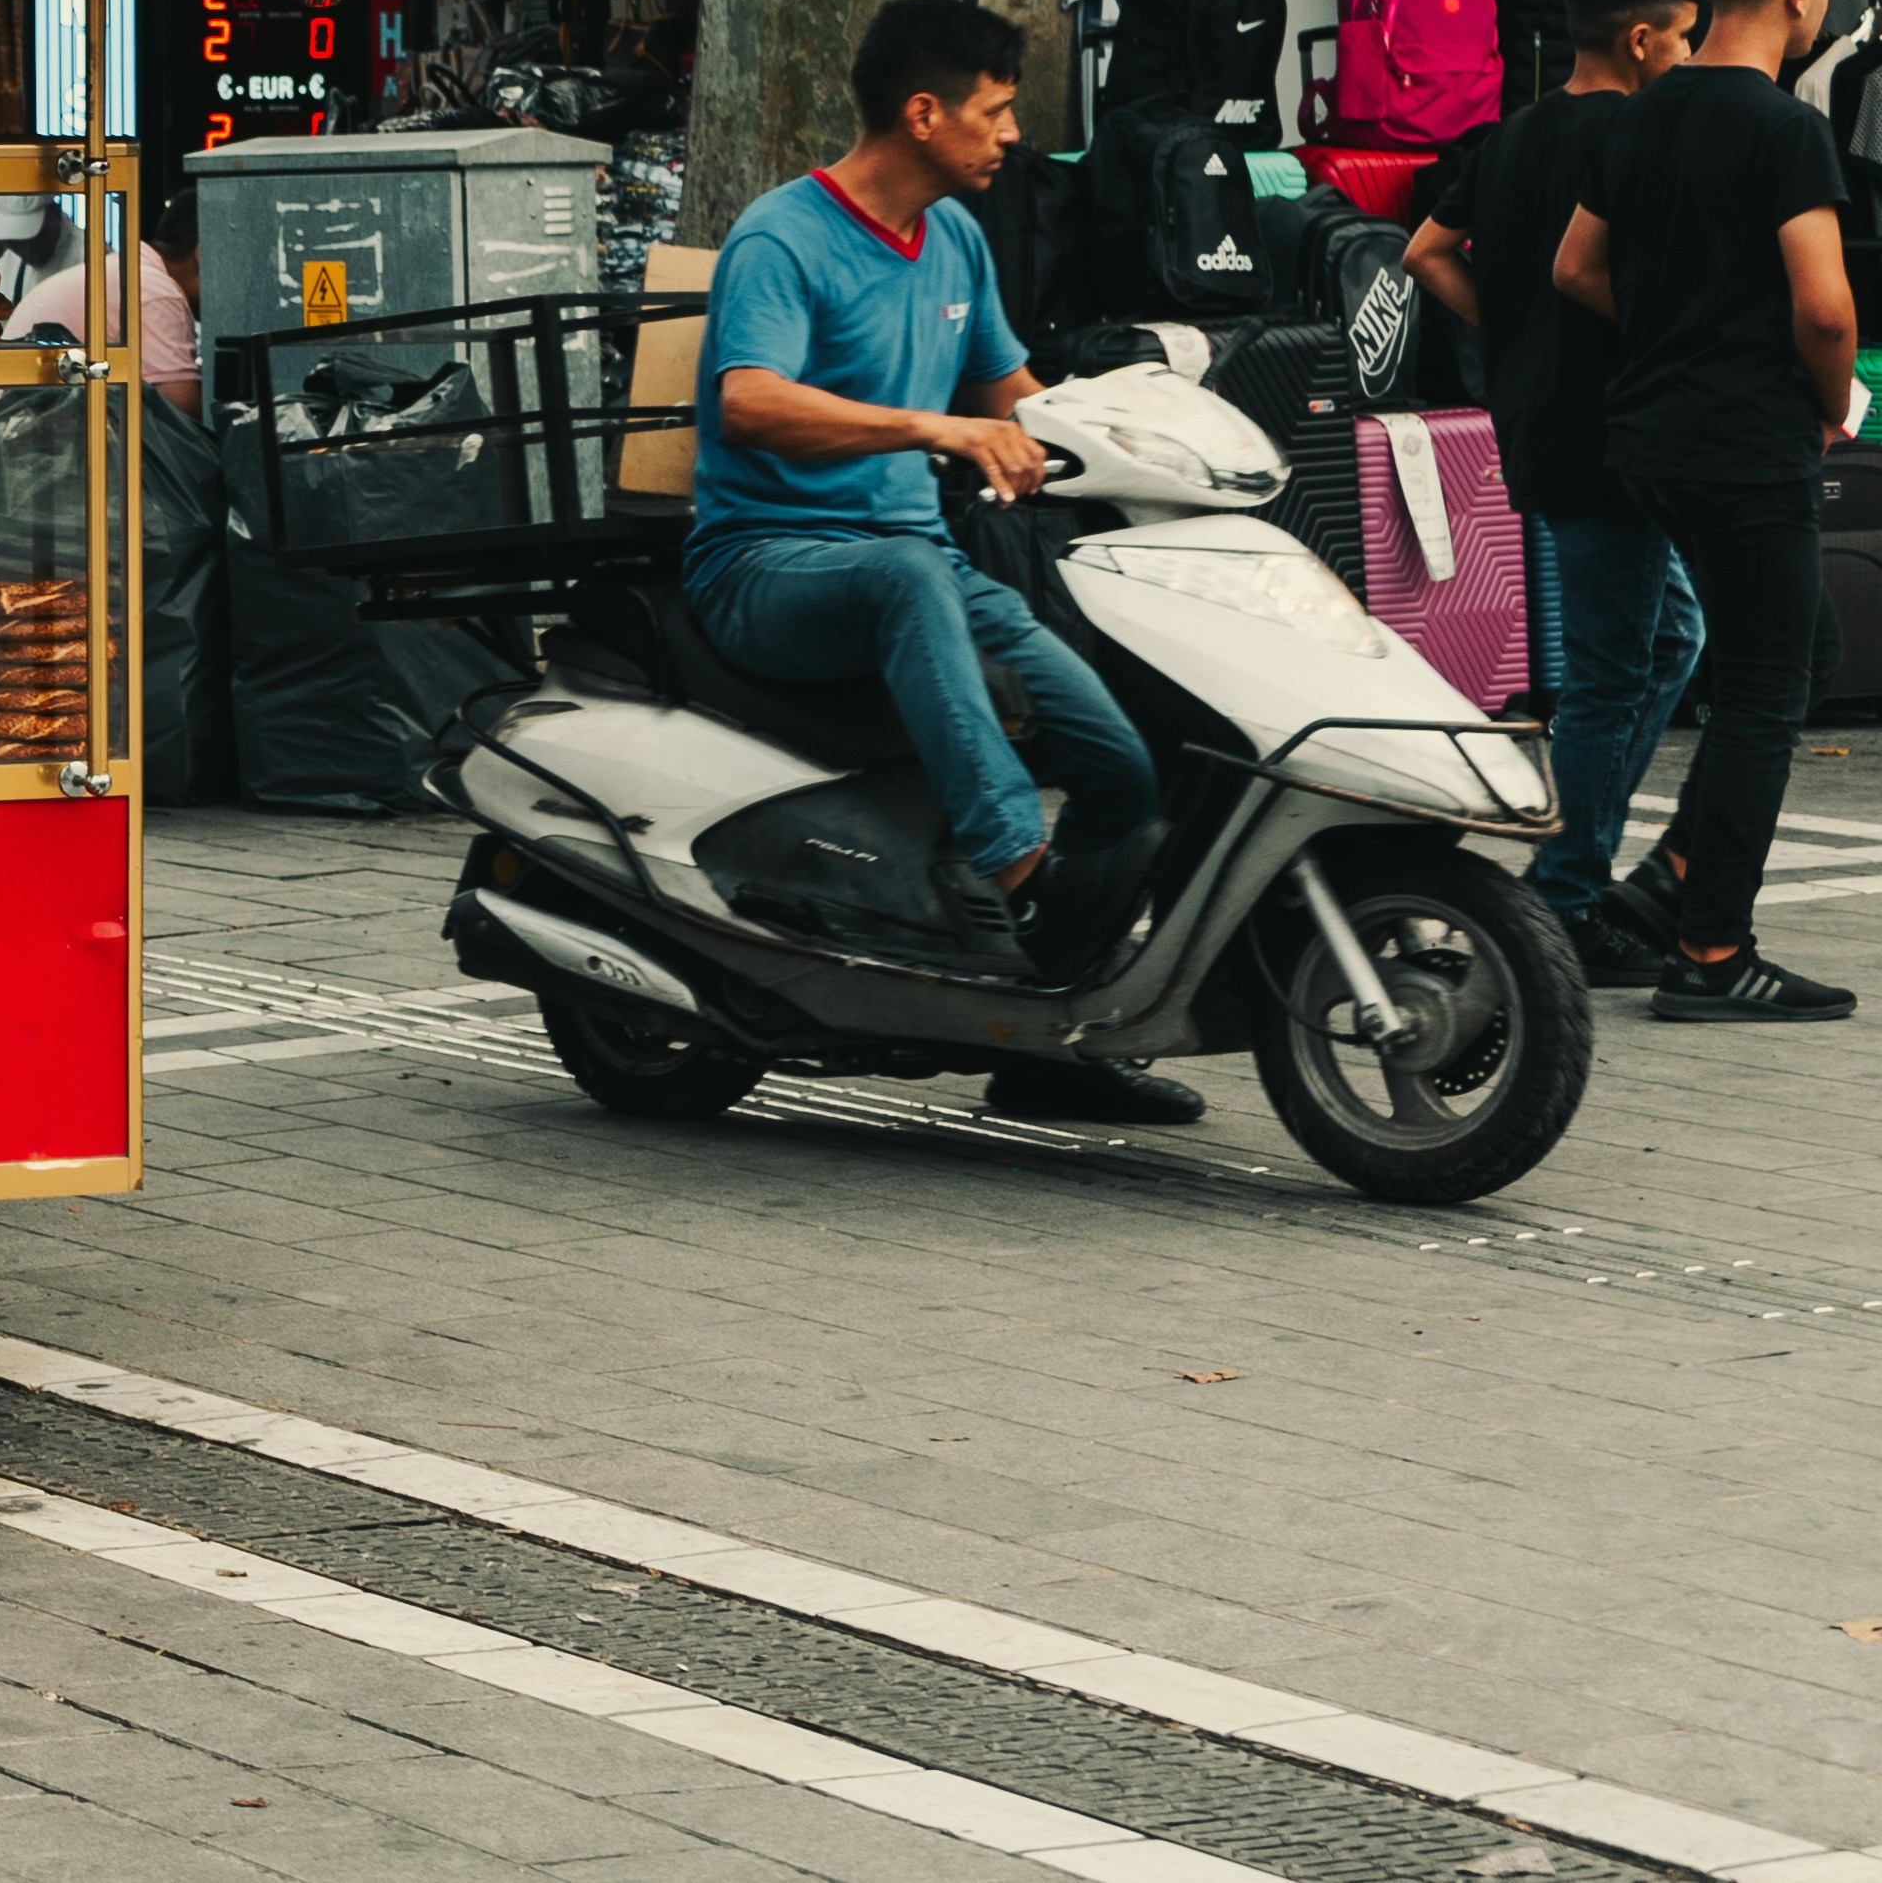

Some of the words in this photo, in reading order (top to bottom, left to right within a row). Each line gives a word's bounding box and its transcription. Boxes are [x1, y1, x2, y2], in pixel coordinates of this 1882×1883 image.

[1214, 99, 1265, 124] NIKE
[1196, 251, 1253, 271] adidas
[1348, 267, 1409, 370] NIKE
